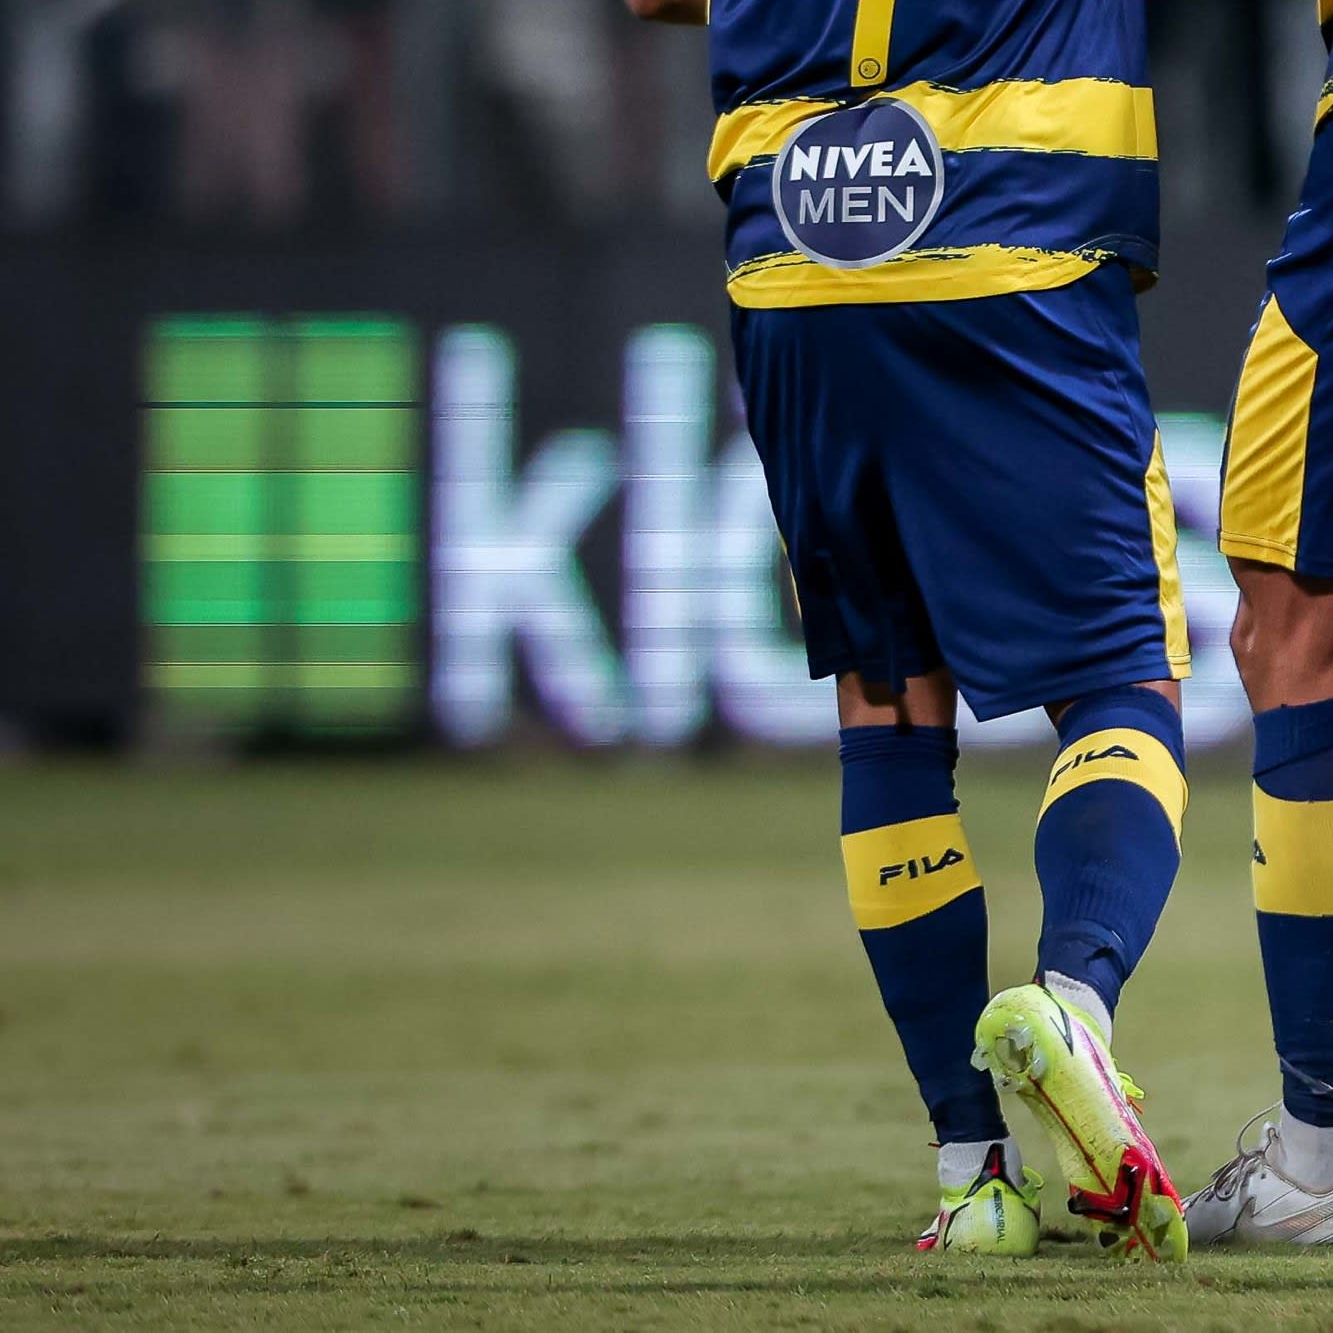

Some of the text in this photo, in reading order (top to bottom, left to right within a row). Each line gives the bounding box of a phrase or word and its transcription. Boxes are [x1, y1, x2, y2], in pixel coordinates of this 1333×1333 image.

[790, 139, 932, 182] NIVEA
[799, 186, 915, 224] MEN
[1049, 744, 1139, 785] FILA
[880, 846, 965, 886] FILA
